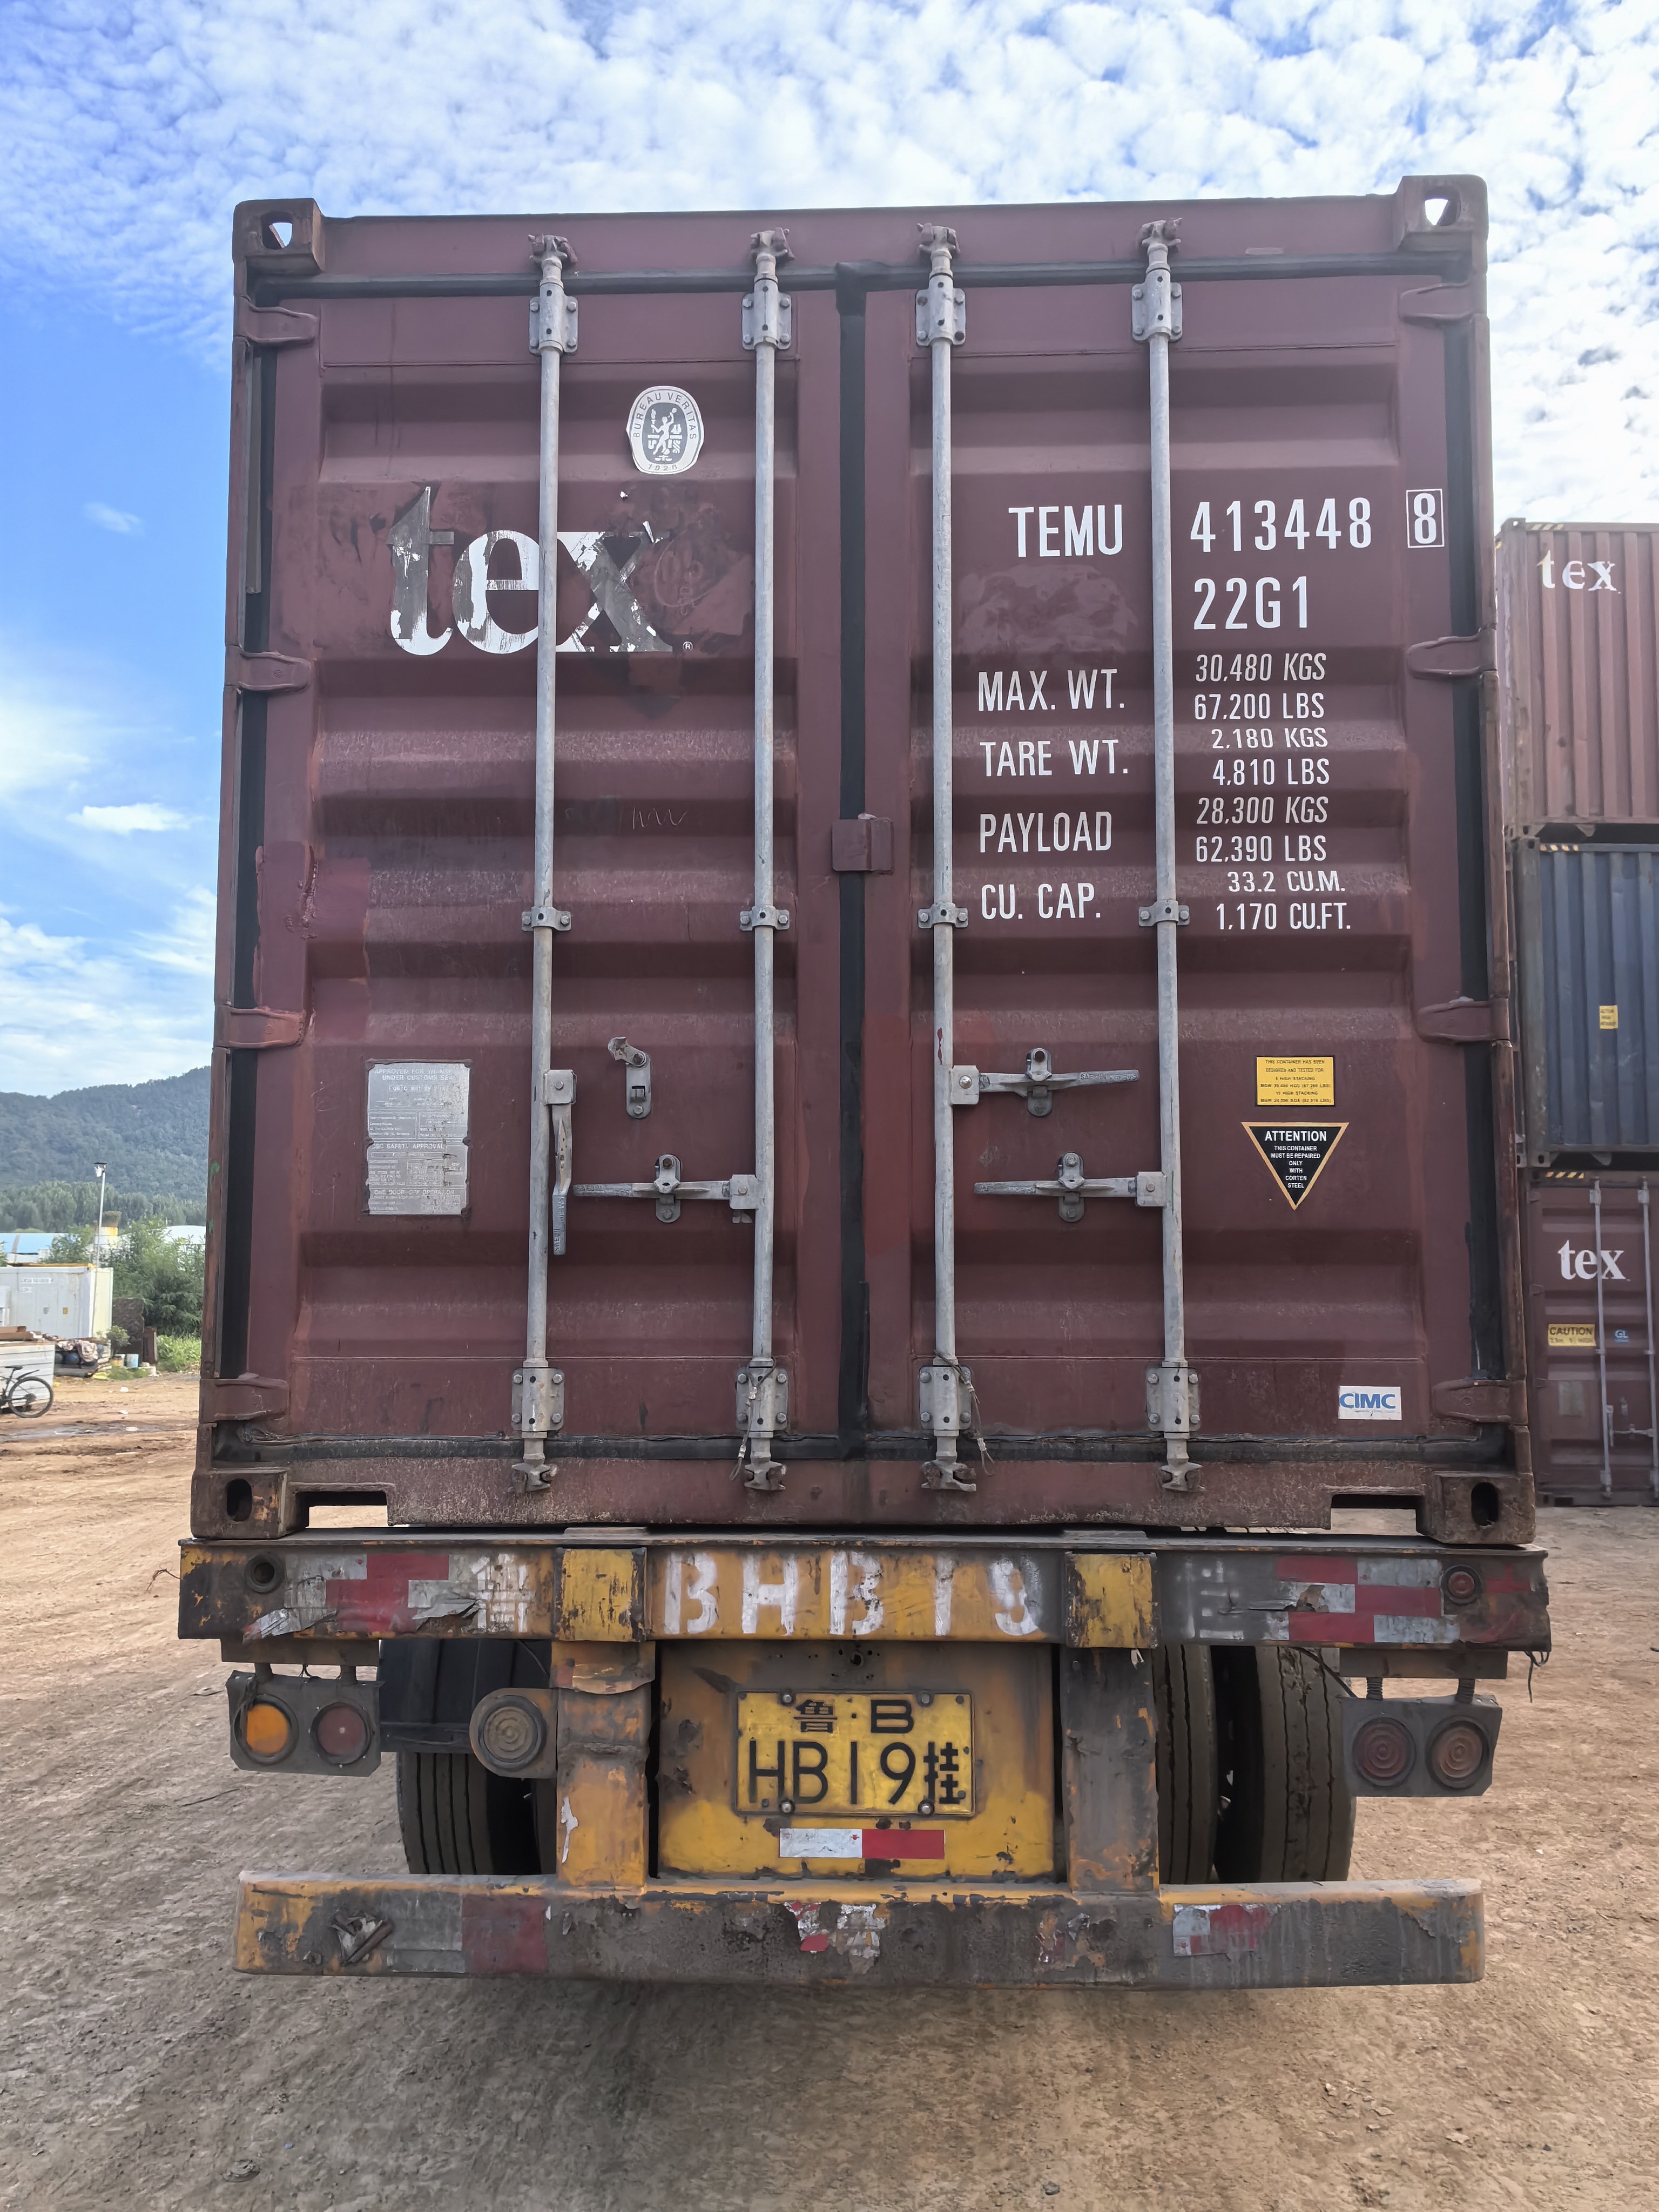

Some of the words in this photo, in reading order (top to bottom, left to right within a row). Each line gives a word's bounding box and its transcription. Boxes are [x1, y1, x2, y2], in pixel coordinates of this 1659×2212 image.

[633, 392, 662, 438] BUREAU
[667, 392, 697, 440] VERITAS
[1009, 504, 1123, 558] TEMU
[1191, 497, 1371, 552] 413448
[1413, 493, 1437, 544] 8
[386, 487, 673, 656] tex
[1537, 550, 1618, 592] tex
[1194, 576, 1307, 630] 22G1
[1196, 653, 1272, 682] 30,480
[1284, 653, 1326, 681] KGS
[978, 670, 1056, 711] MAX.
[1068, 669, 1125, 710] WT.
[1195, 693, 1270, 720] 67,200
[1283, 693, 1324, 719] LBS
[1211, 729, 1273, 749] 2,180
[1284, 727, 1328, 748] KGS
[980, 741, 1052, 777] TARE
[1068, 739, 1128, 775] WT.
[1213, 759, 1275, 785] 4,810
[1287, 758, 1330, 785] LBS
[1196, 797, 1274, 824] 28,300
[1285, 797, 1328, 824] KGS
[980, 811, 1112, 853] PAYLOAD
[1196, 836, 1272, 862] 62,390
[1285, 835, 1326, 861] LBS
[1227, 871, 1276, 892] 33.2
[1286, 871, 1345, 892] CU.M.
[981, 884, 1023, 920] CU.
[1038, 882, 1101, 919] CAP.
[1216, 903, 1277, 930] 1,170
[1290, 902, 1351, 929] CU.FT.
[1265, 1130, 1327, 1141] ATTENTION
[1557, 1239, 1627, 1280] tex
[1550, 1326, 1592, 1336] CAUTION
[1339, 1393, 1396, 1410] CIMC
